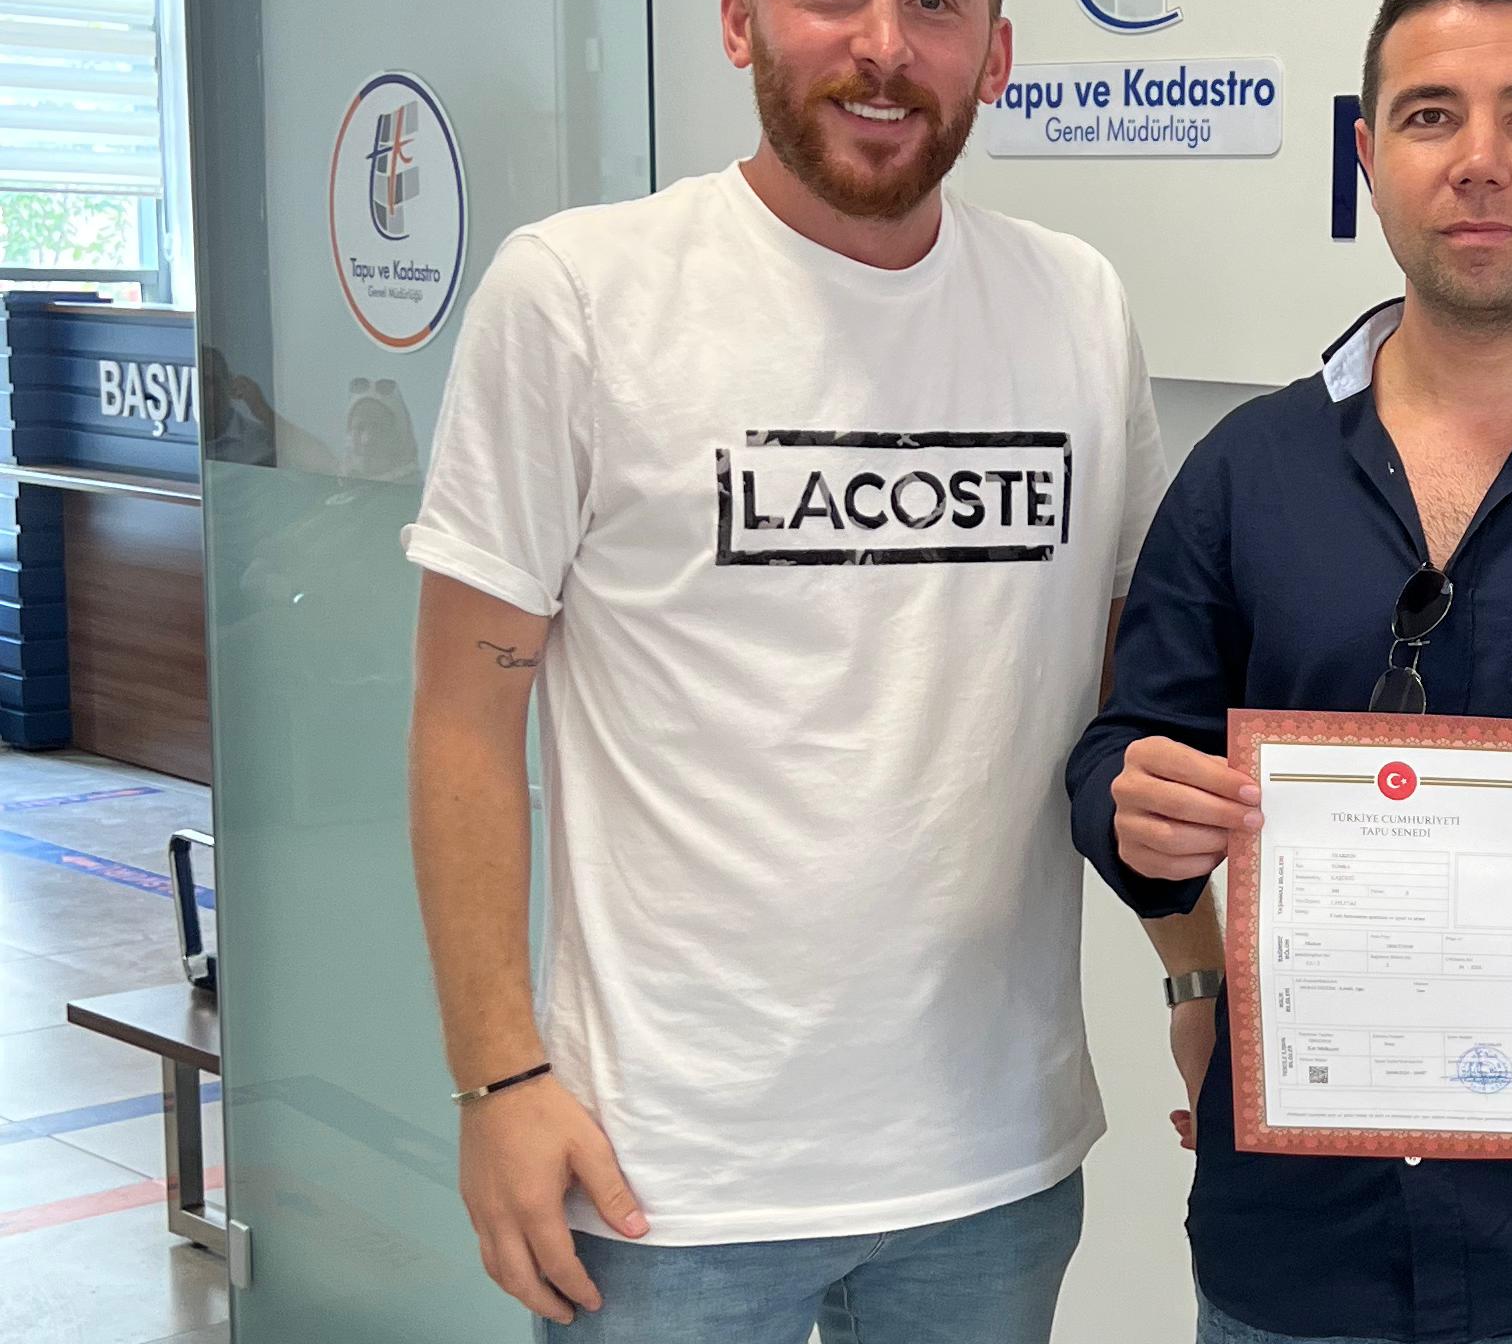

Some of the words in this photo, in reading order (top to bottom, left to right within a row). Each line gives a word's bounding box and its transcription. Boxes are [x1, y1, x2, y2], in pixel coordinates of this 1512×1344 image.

[996, 82, 1063, 119] apu
[1075, 81, 1111, 107] ve
[1123, 66, 1275, 107] Kadastro
[1045, 116, 1100, 142] Genel
[1107, 117, 1211, 148] Müdürlüğü
[350, 258, 375, 283] Tapu
[378, 265, 390, 279] ve
[393, 260, 440, 283] Kadastro
[742, 470, 1055, 531] LACOSTE
[1331, 811, 1380, 824] TÜRKİYE
[1381, 814, 1461, 826] CUMHURİYETİ
[1360, 826, 1389, 837] TAPU
[1391, 827, 1432, 838] SENEDİ
